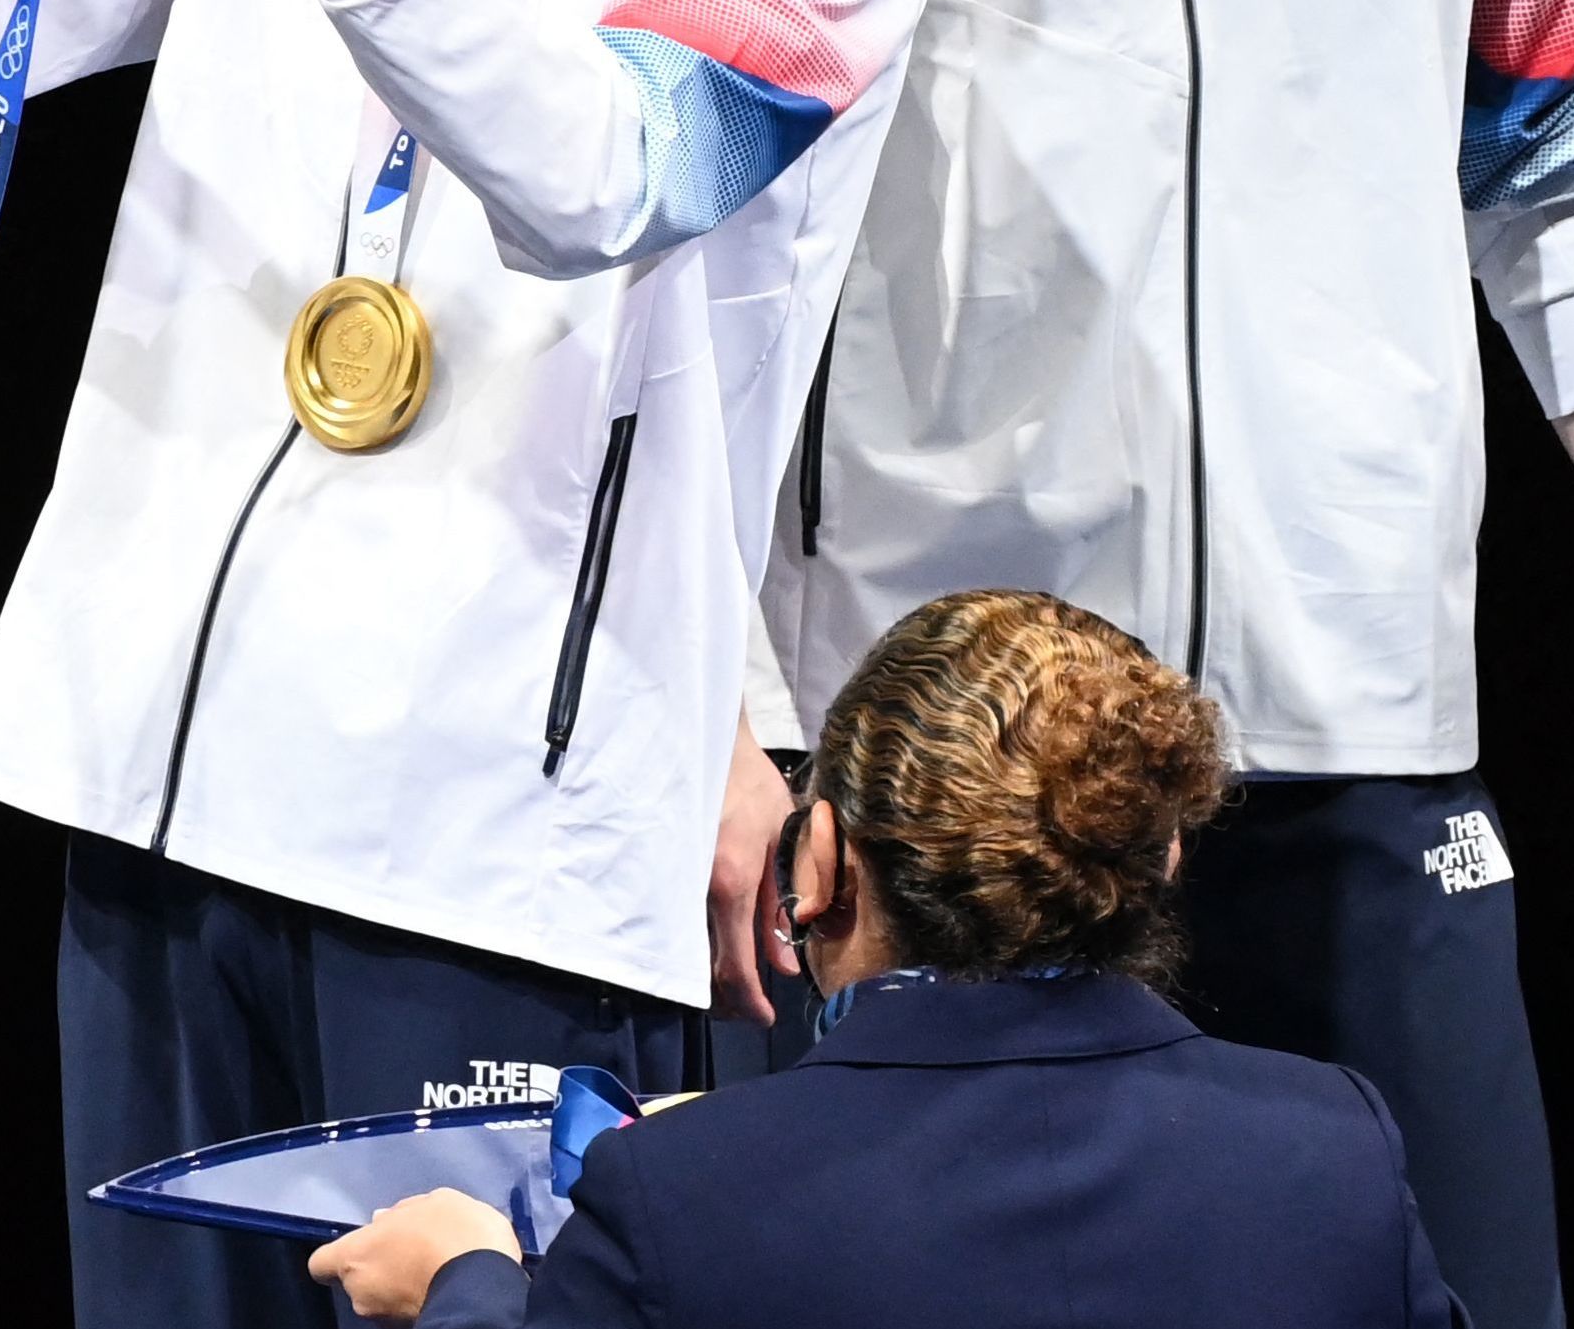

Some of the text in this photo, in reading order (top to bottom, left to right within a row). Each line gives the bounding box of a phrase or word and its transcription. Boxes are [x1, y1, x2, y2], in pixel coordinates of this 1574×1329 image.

[1444, 812, 1482, 842] THE
[1423, 834, 1487, 875] NORTH
[1439, 862, 1489, 895] FACE
[469, 1060, 529, 1088] THE
[423, 1081, 530, 1109] NORTH
